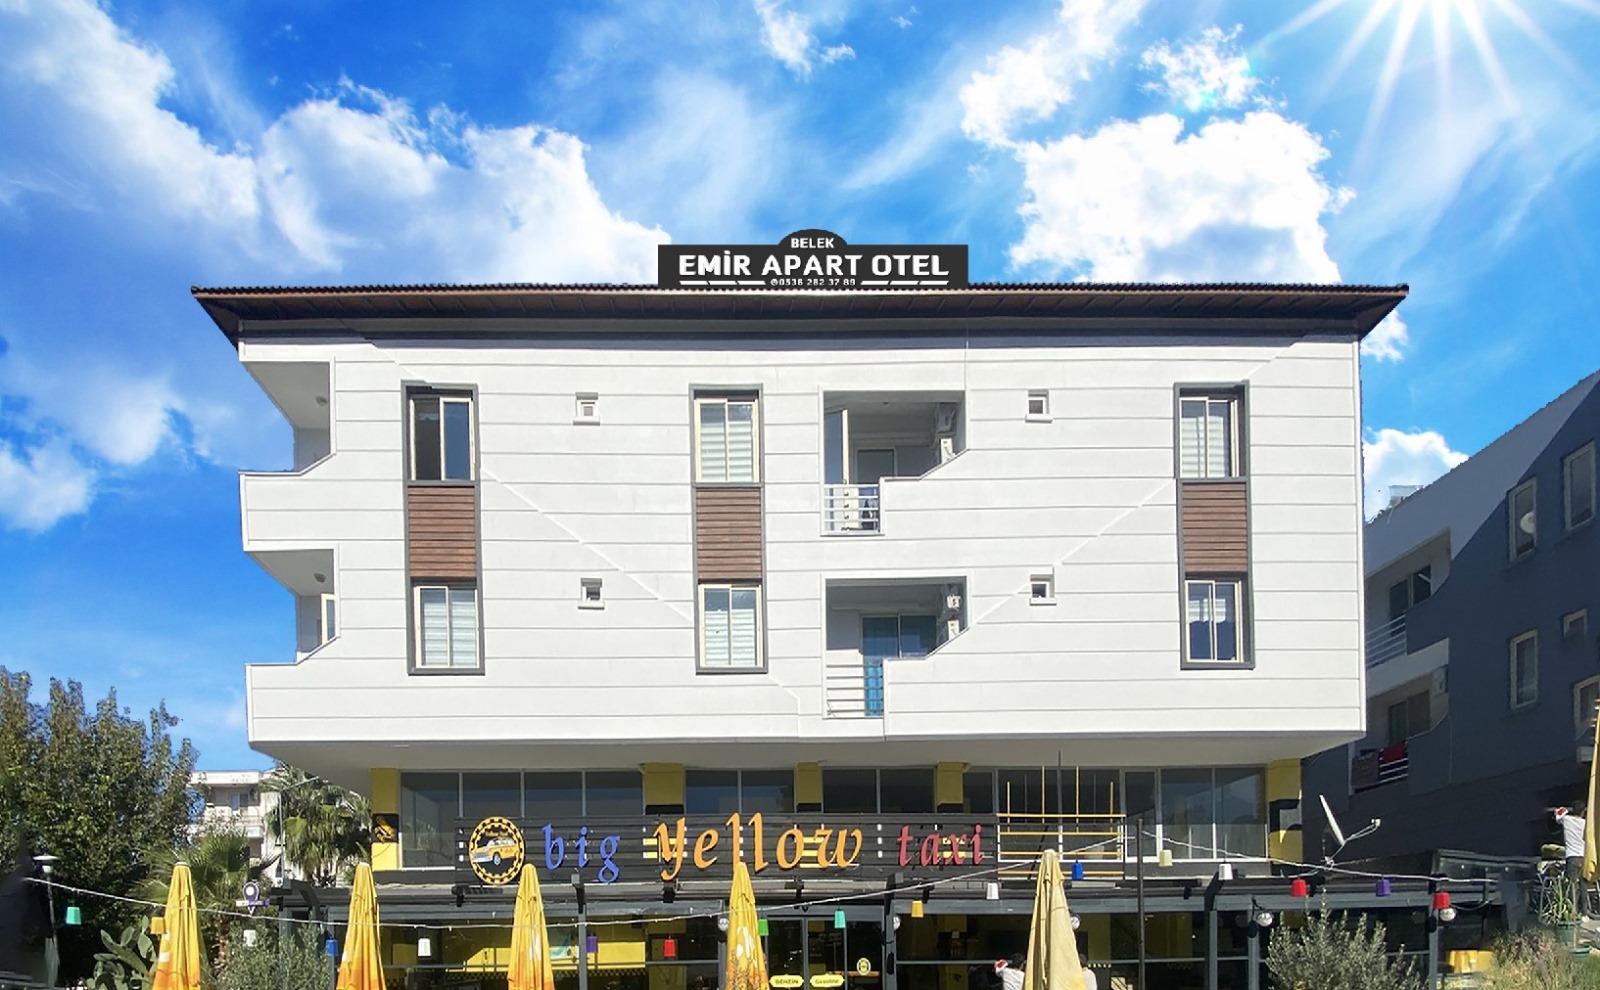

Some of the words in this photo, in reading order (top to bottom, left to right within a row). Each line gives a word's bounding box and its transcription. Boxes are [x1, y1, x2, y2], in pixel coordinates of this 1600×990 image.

[790, 237, 835, 249] BELEK
[678, 250, 752, 276] EMİR
[761, 254, 863, 276] APART
[871, 254, 950, 276] OTEL
[779, 278, 804, 287] 0536
[806, 278, 826, 287] 282
[828, 278, 840, 287] 37
[843, 278, 857, 287] 89
[542, 823, 621, 884] big
[656, 812, 864, 882] yellow
[897, 824, 984, 867] taxi
